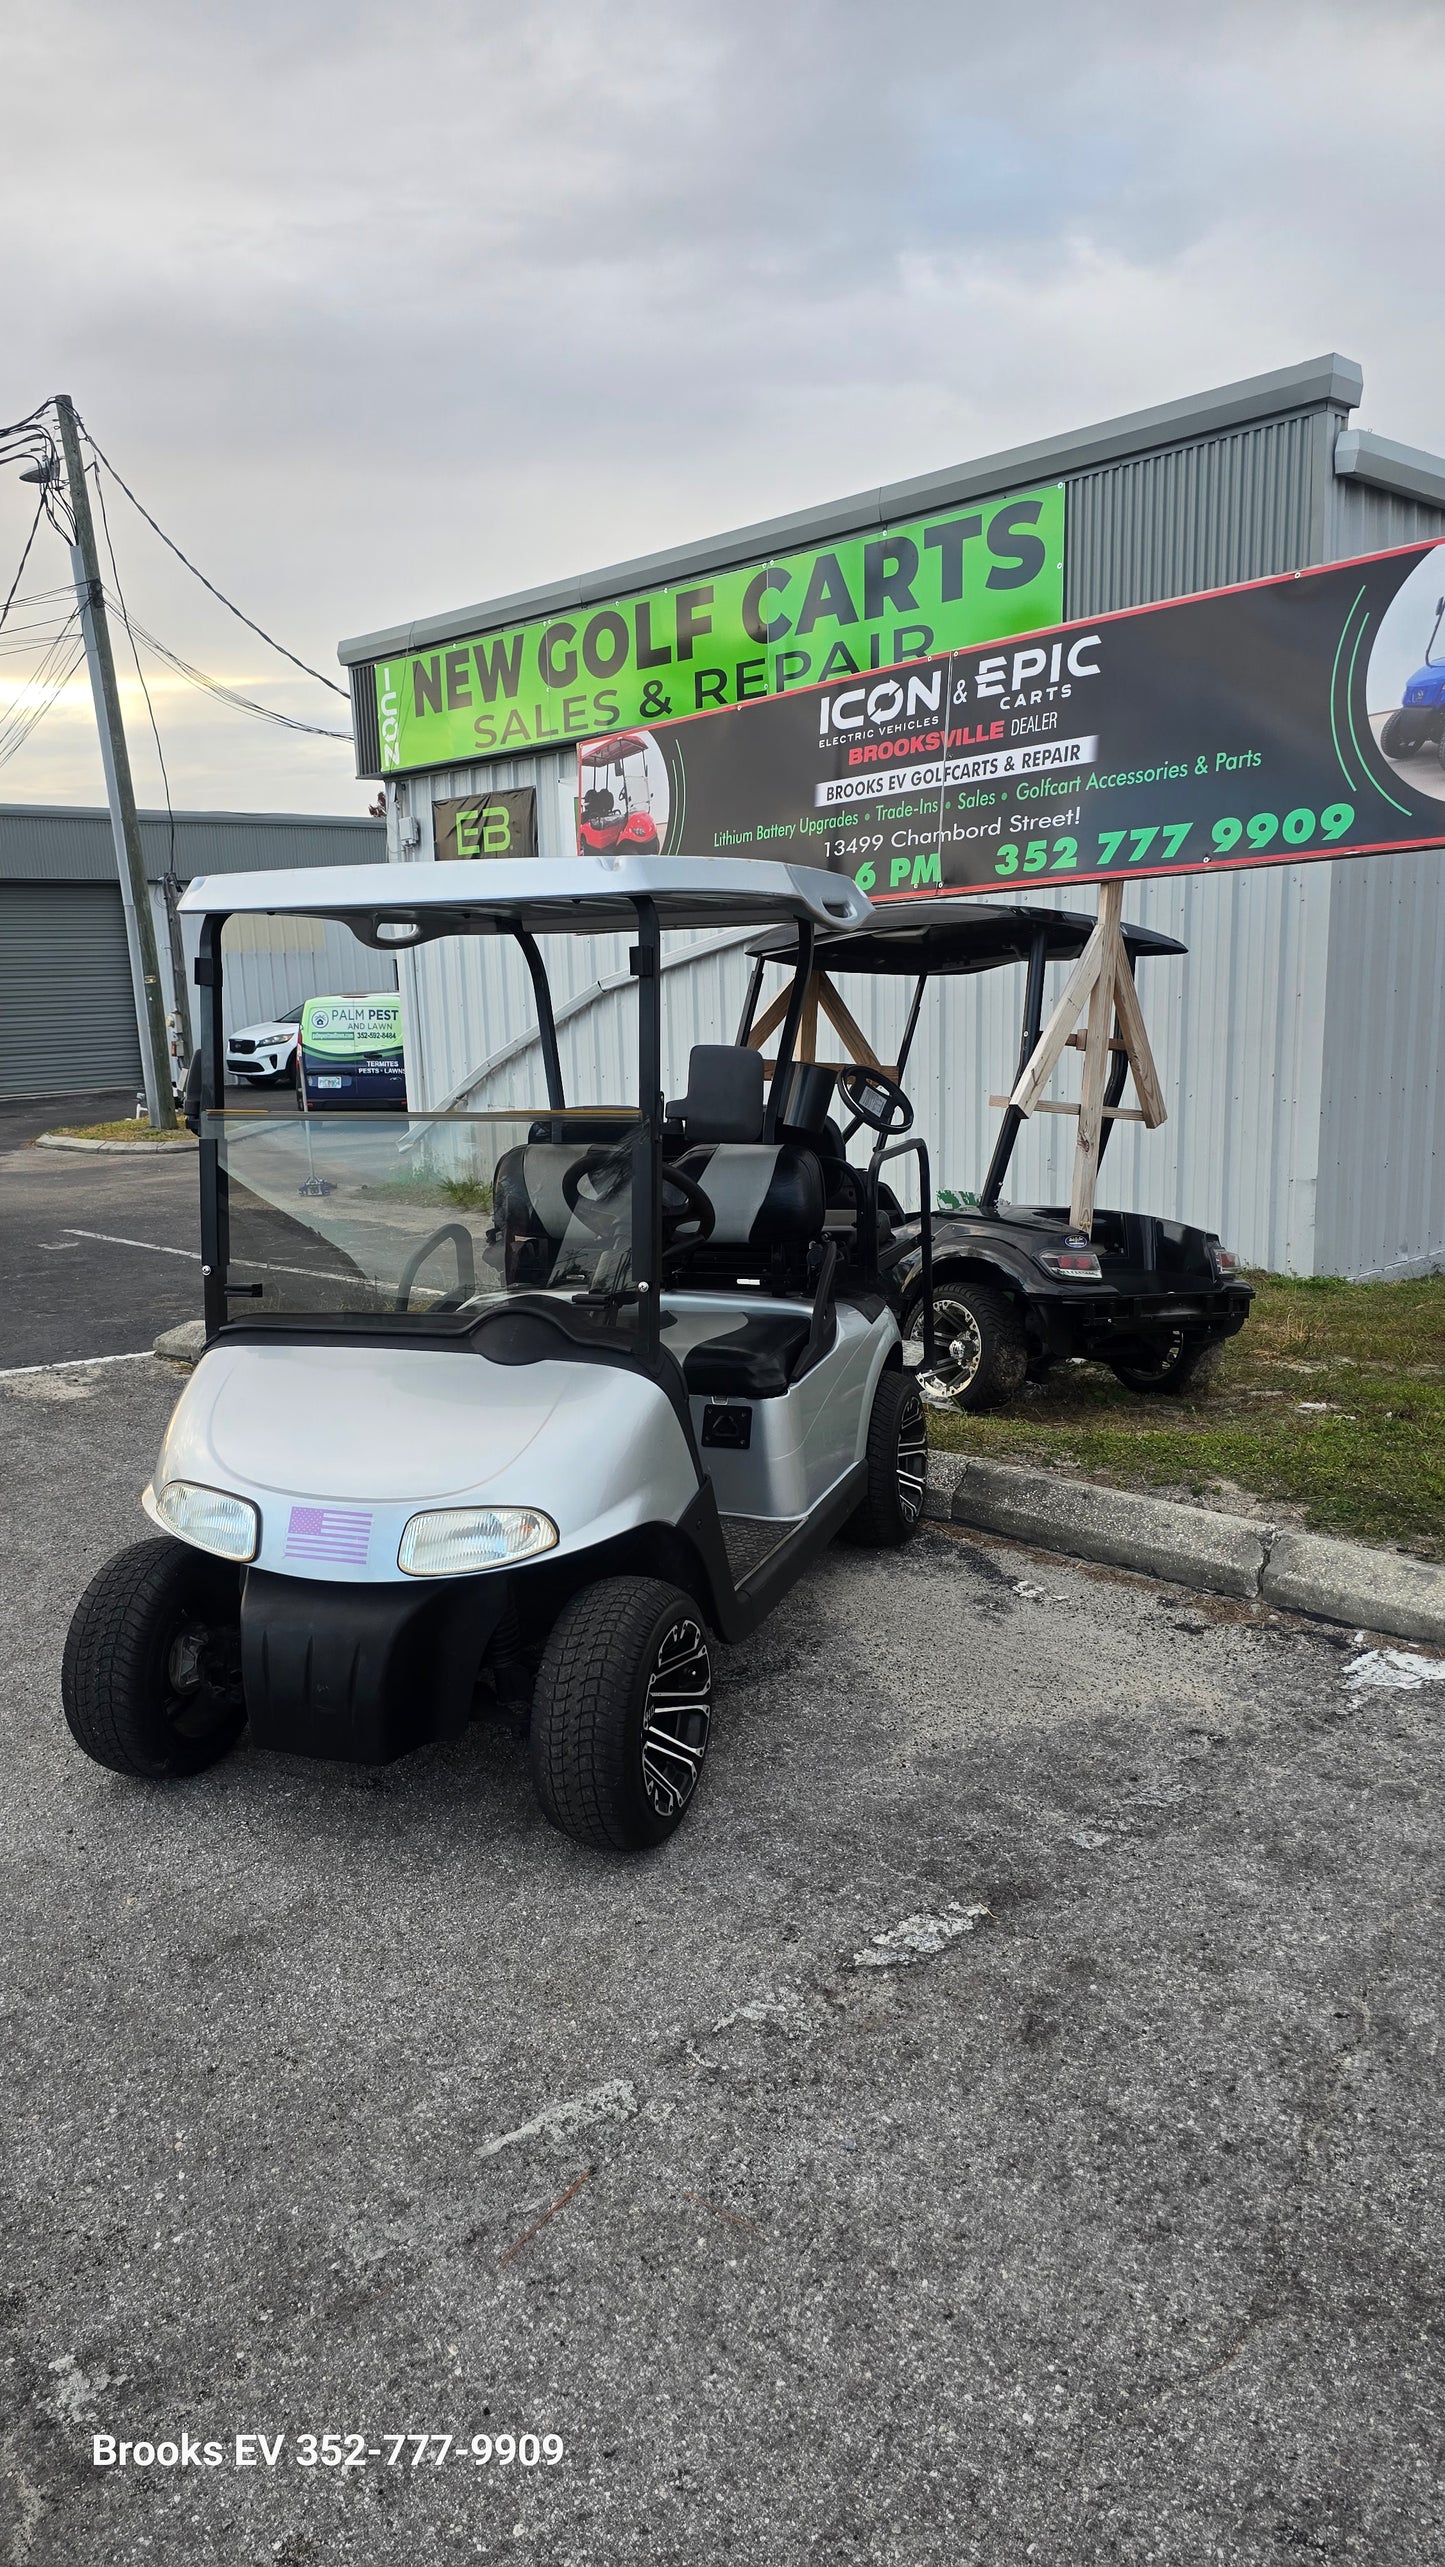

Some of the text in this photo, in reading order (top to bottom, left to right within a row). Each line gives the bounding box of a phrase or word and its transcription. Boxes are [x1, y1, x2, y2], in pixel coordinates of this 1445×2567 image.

[412, 501, 1045, 718] NEW GOLF CARTS
[474, 625, 935, 749] SALES & REPAIR
[819, 634, 1102, 735] ICON & EPIC
[1000, 683, 1072, 710] CARTS
[380, 667, 400, 767] ICON
[819, 715, 939, 748] ELECTRIC VEHICLES
[848, 711, 1058, 766] BROOKSVILLE DEALER
[713, 750, 1262, 848] Lithium Battery Upgrades Trade-Ins Sales Golfcart Accessories & Parts
[826, 744, 1081, 802] BROOKS EV GOLFCARTS & REPAIR
[455, 806, 511, 856] EB
[824, 806, 1081, 858] 13499 Chambord Street!
[855, 803, 1355, 891] 6 PM 352 777 9909
[331, 1009, 399, 1021] PALM PEST
[347, 1022, 393, 1030] AND LAWN
